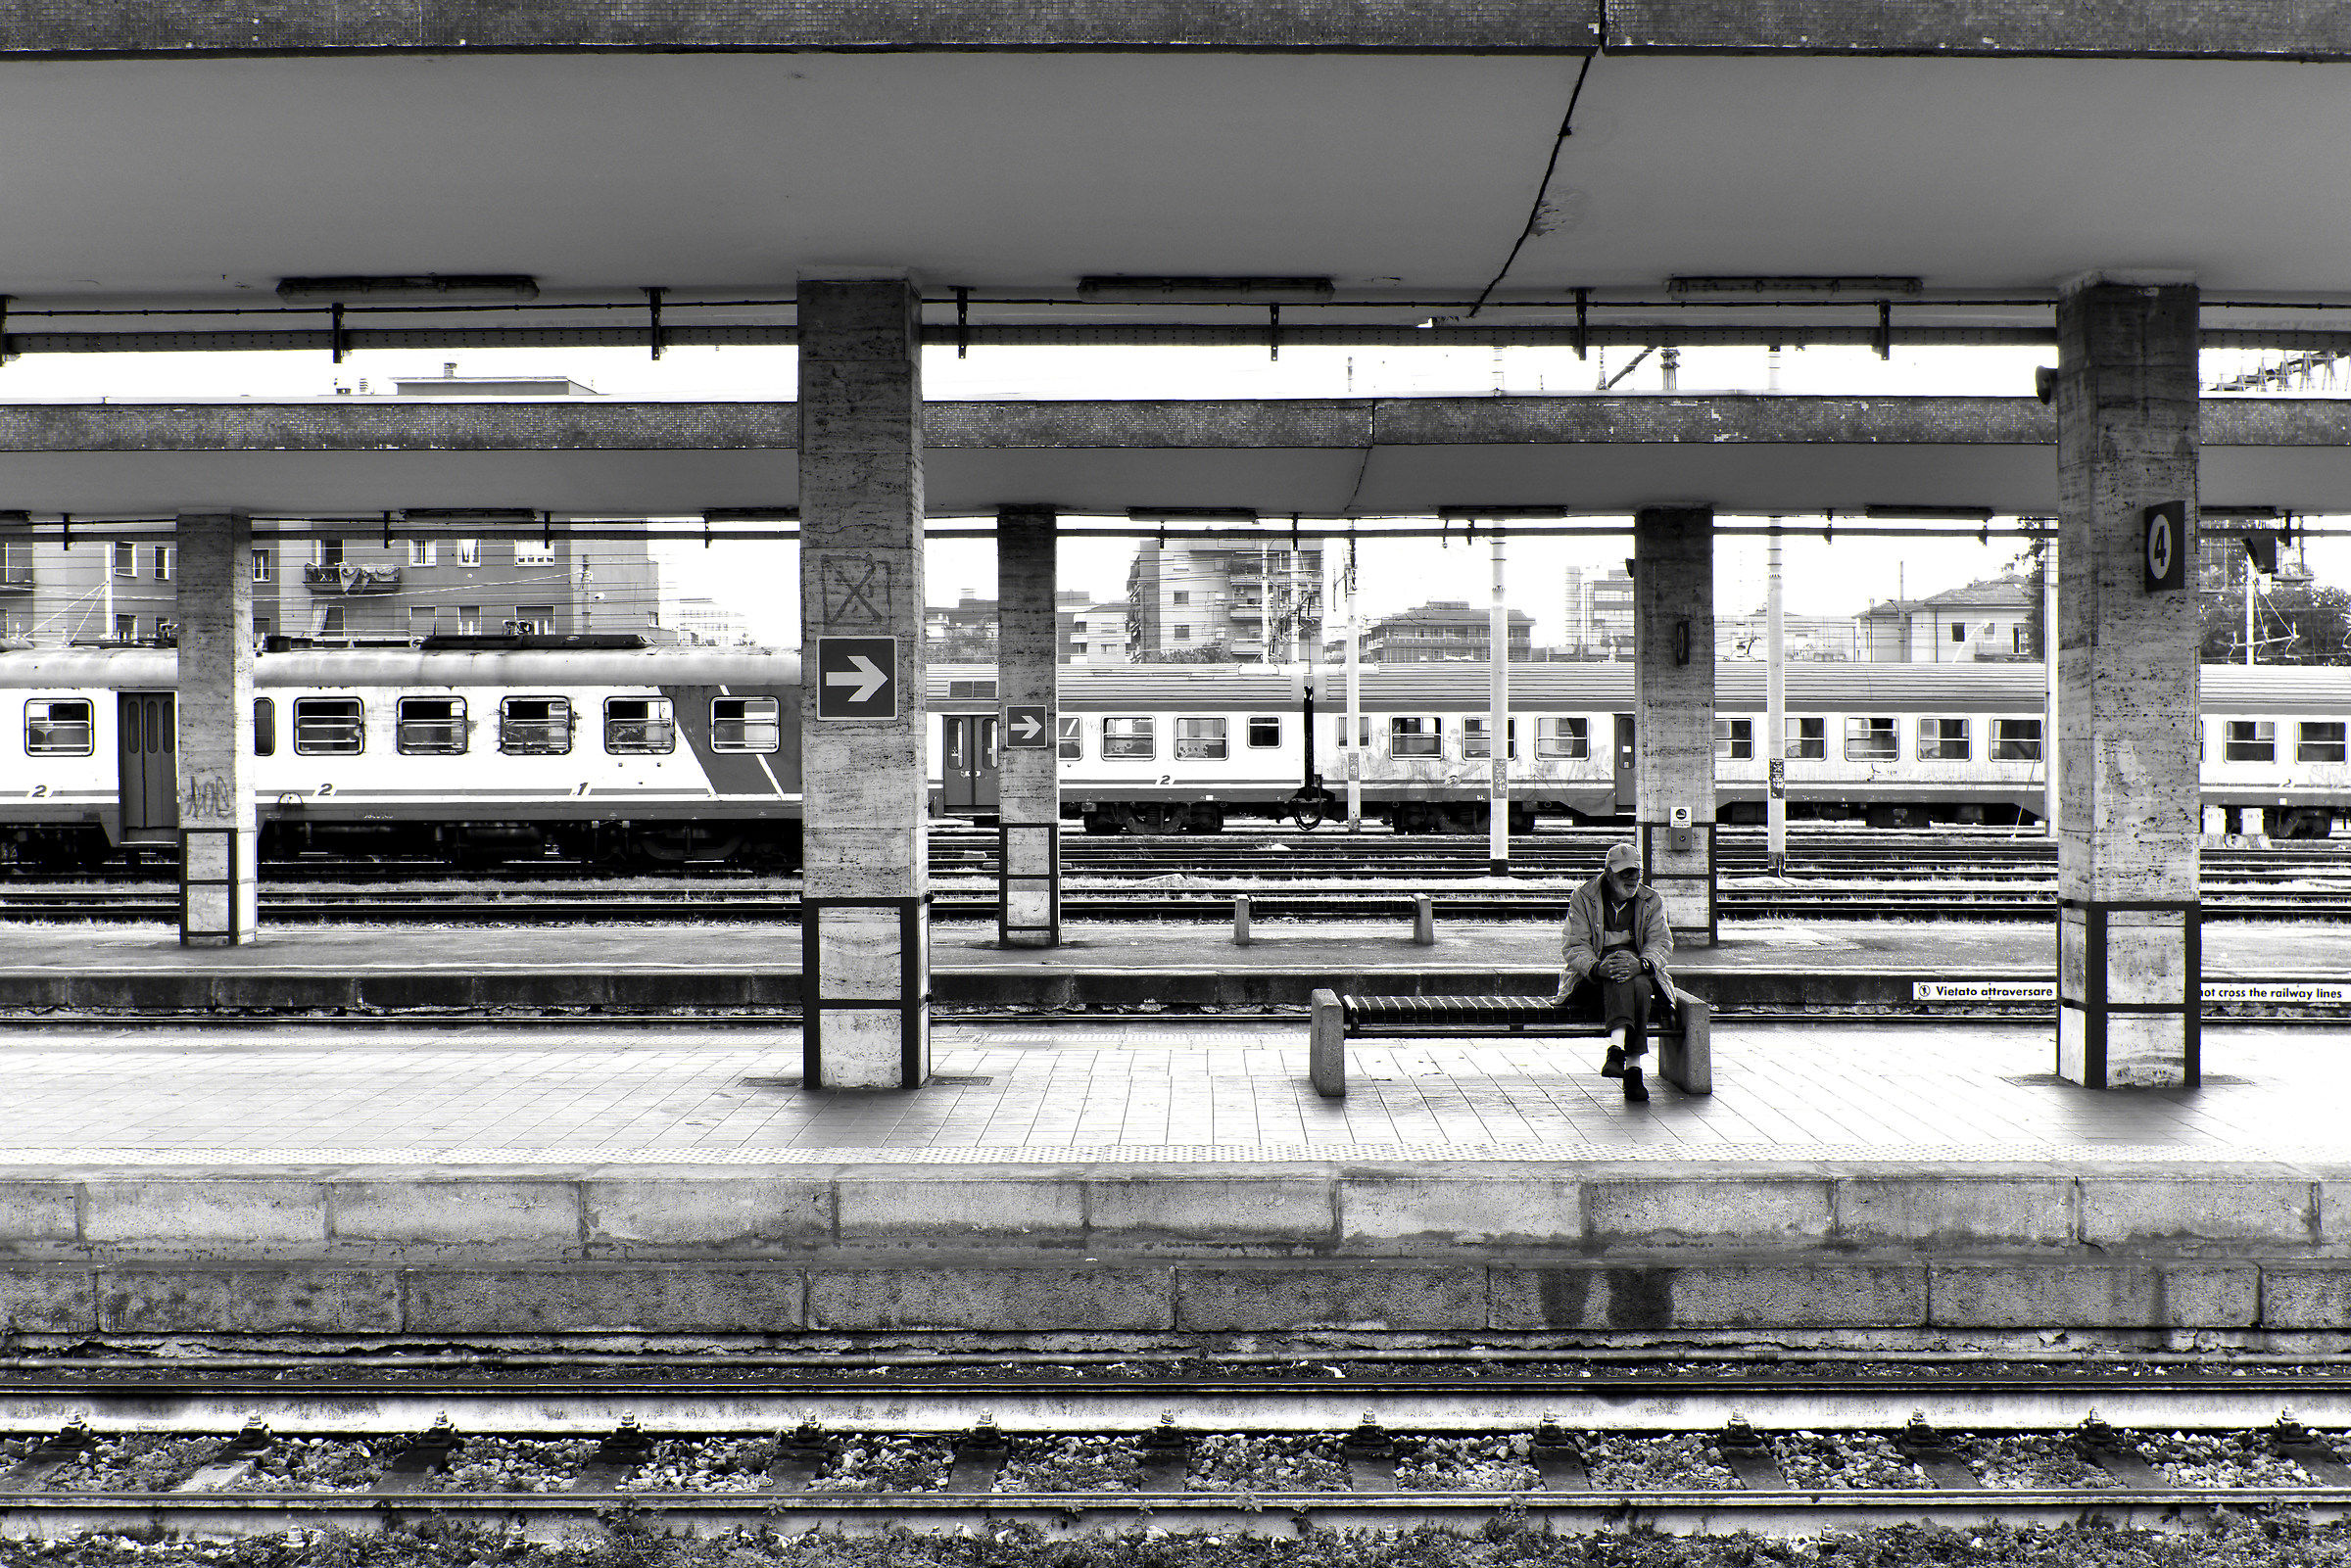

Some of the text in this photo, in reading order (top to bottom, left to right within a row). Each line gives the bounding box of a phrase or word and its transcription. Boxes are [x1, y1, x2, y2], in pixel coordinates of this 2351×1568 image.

[2154, 525, 2166, 566] 4
[1160, 775, 1171, 784] 2
[32, 784, 47, 797] 2
[318, 783, 333, 796] 2
[577, 782, 588, 795] 1
[1936, 985, 2053, 996] Vietato attraversare
[2219, 988, 2246, 998] cross
[2249, 987, 2268, 998] the
[2270, 987, 2314, 1000] railway
[2316, 987, 2343, 998] lines
